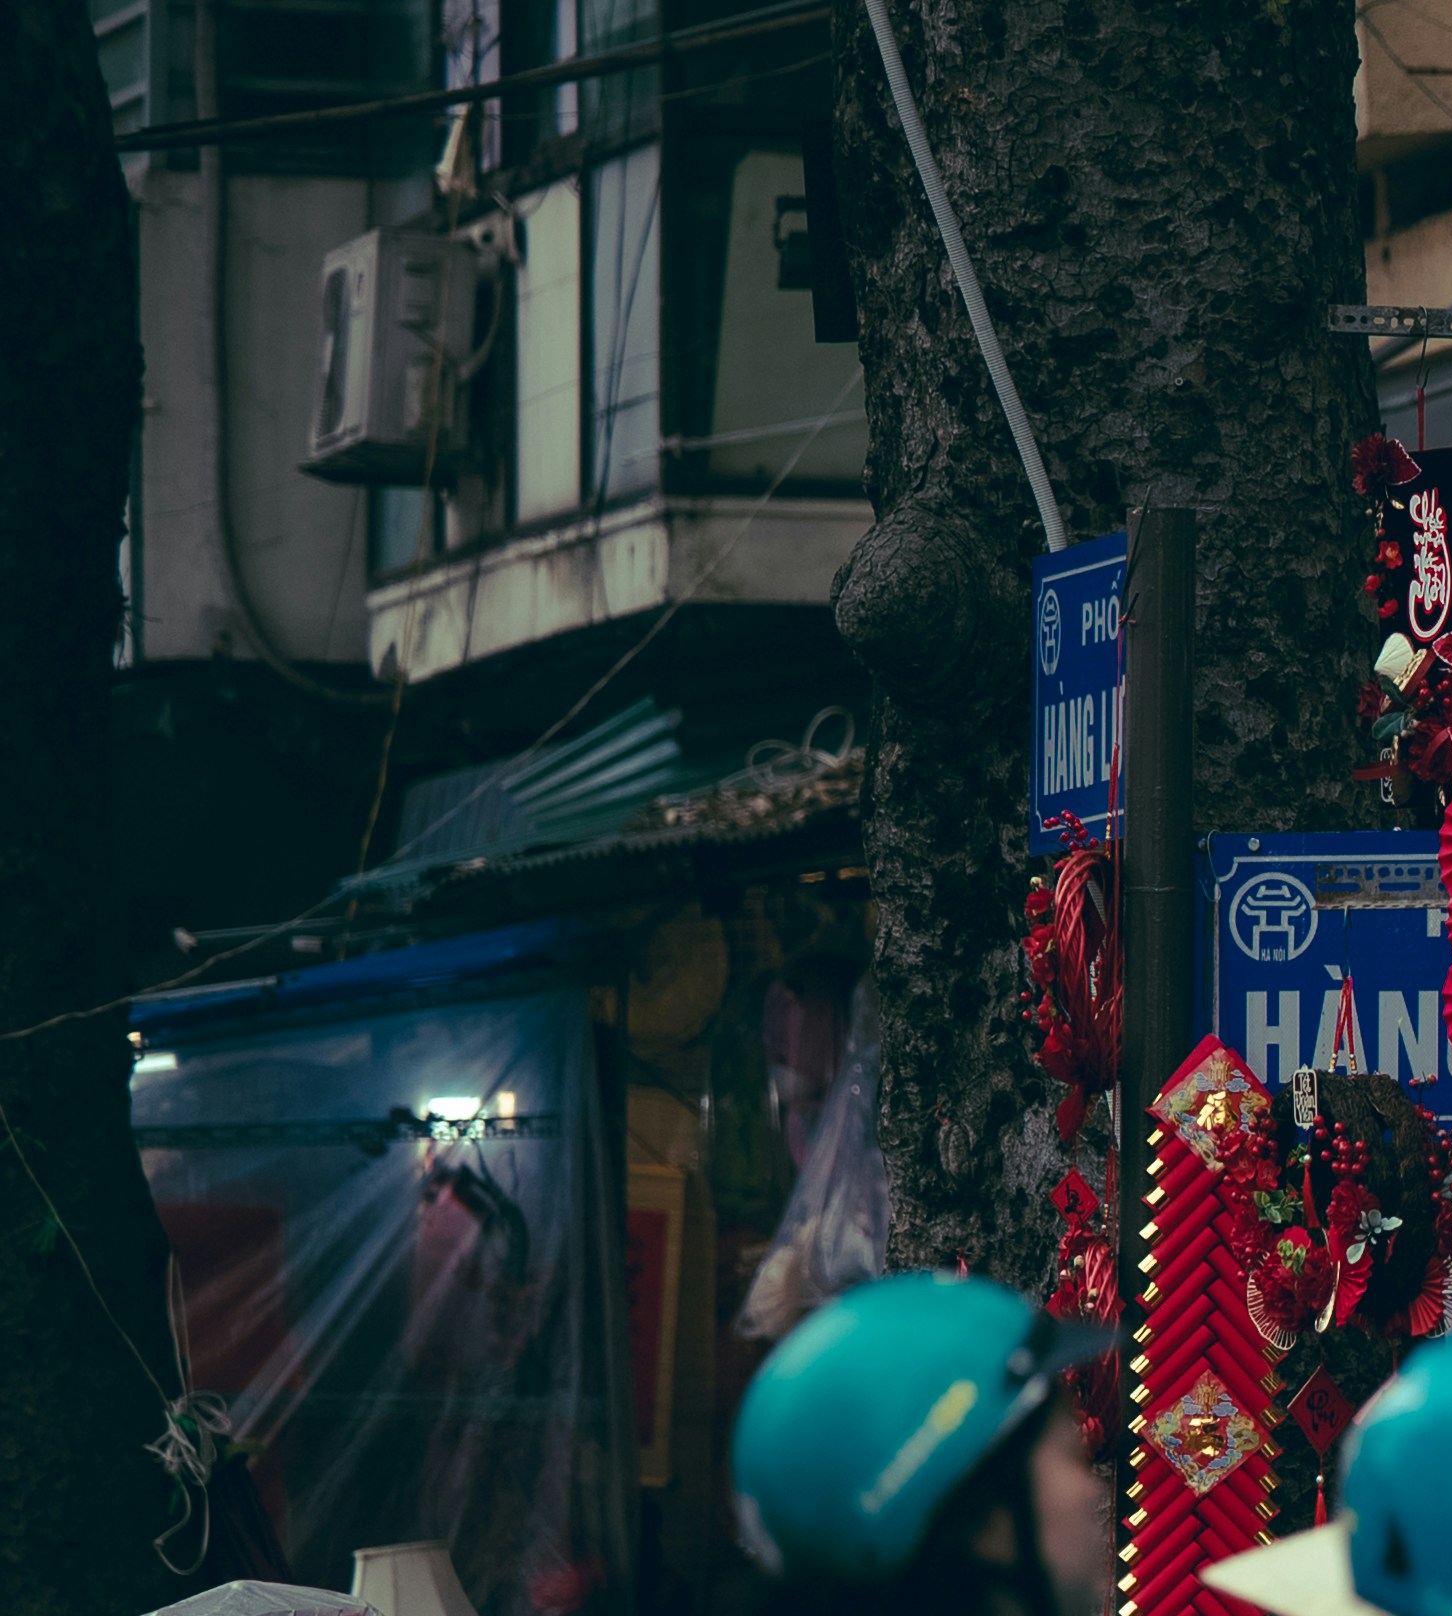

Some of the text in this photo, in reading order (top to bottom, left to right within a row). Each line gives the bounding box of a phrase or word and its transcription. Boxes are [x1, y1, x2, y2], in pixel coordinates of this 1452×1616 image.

[1081, 569, 1120, 646] PHỐ
[1043, 680, 1094, 796] HÀNG
[1261, 947, 1286, 964] HÀ NỘI
